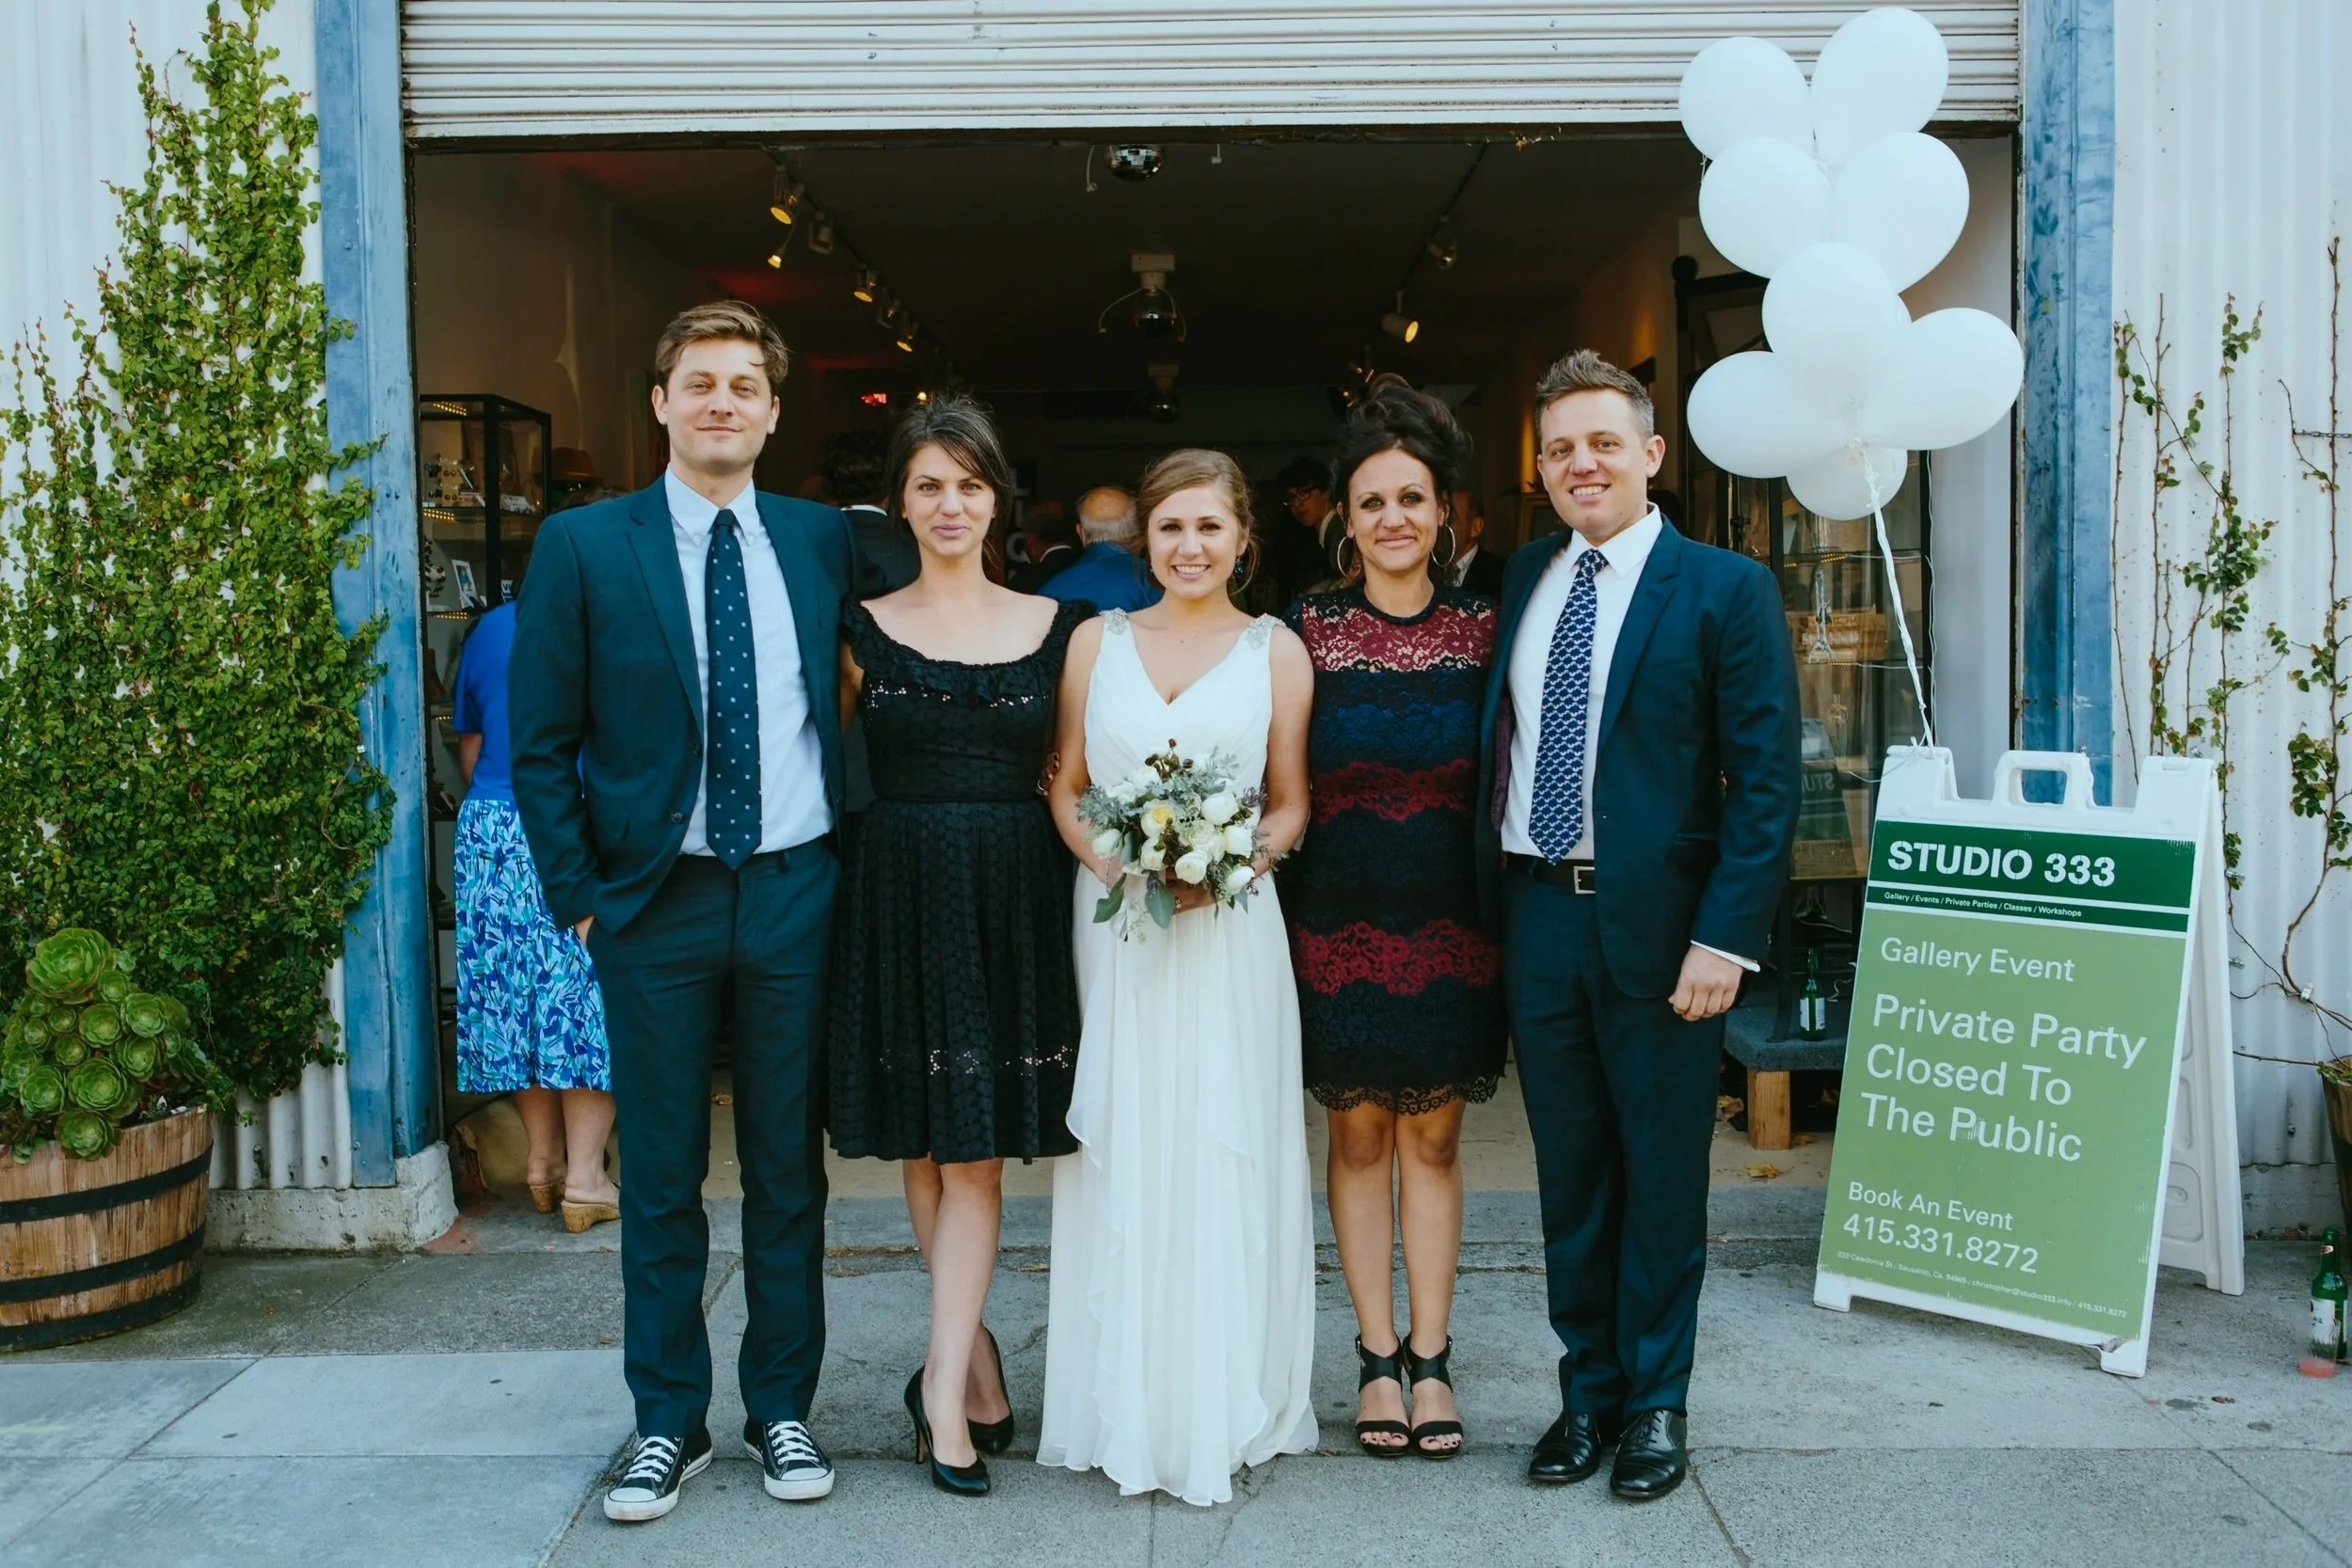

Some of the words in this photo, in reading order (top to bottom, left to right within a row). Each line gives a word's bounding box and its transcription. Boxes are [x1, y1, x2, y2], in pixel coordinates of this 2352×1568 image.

[1887, 840, 2032, 880] STUDIO
[2043, 852, 2116, 887] 333
[1884, 892, 1910, 902] Gallery
[1915, 895, 1940, 904] Events
[1946, 897, 1971, 907] Private
[1973, 900, 1998, 910] Parties
[2004, 903, 2032, 912] Classes
[2039, 906, 2082, 917] Workshops
[1881, 937, 1981, 976] Gallery
[1990, 949, 2075, 981] Event
[1873, 993, 2015, 1044] Private
[2030, 1013, 2147, 1069] Party
[1867, 1043, 2007, 1096] Closed
[2022, 1064, 2071, 1106] To
[1861, 1092, 1935, 1137] The
[1949, 1106, 2082, 1162] Public
[1849, 1181, 1902, 1210] Book
[1908, 1193, 1940, 1217] An
[1947, 1200, 2013, 1231] Event
[1843, 1213, 2039, 1274] 415.331.8272
[1972, 1280, 2072, 1306] christopher@studio333.info
